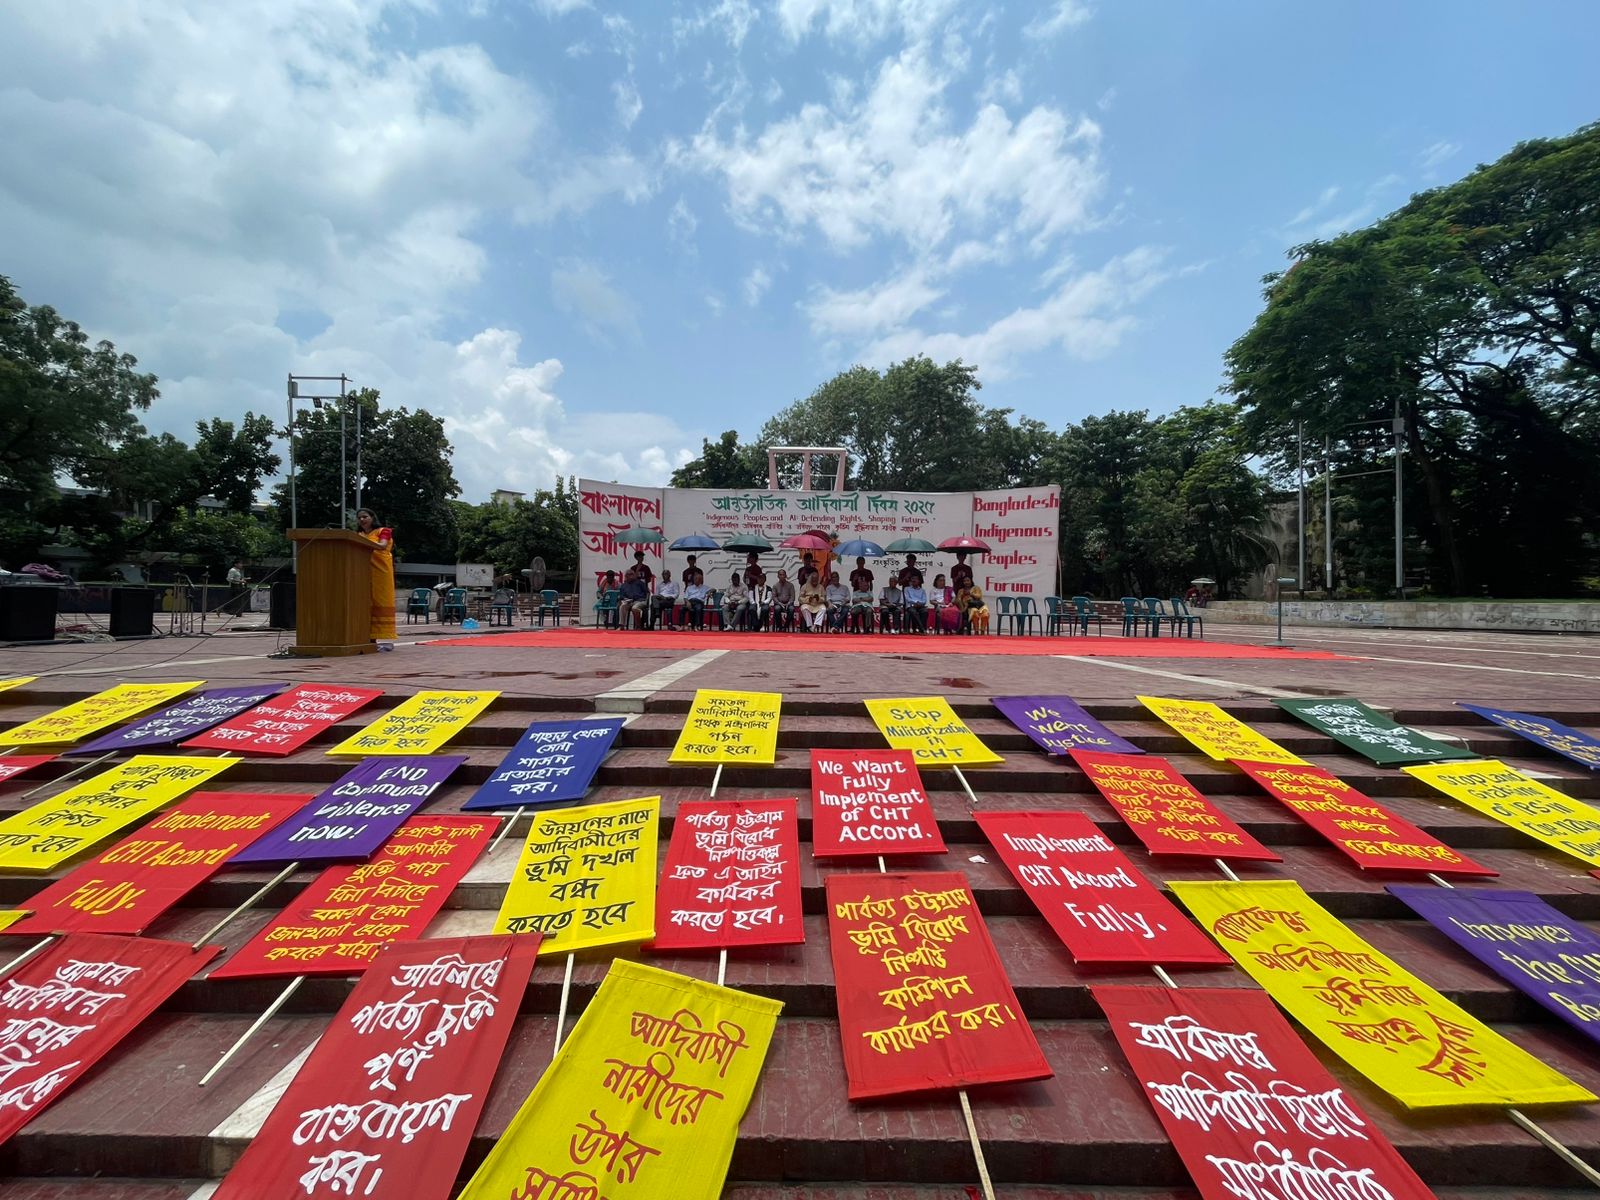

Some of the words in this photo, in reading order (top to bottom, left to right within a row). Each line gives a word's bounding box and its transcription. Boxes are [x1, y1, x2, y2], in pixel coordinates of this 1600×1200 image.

[580, 490, 661, 522] বাংলাদেশ
[795, 492, 859, 514] আদিবাসী
[867, 494, 898, 514] দিবস
[973, 492, 1059, 517] Bangladesh
[975, 523, 1053, 543] Indigenous
[981, 549, 1037, 570] Peoples
[985, 576, 1033, 593] Forum
[890, 709, 941, 721] Stop
[530, 731, 571, 743] পাহাড়
[573, 728, 611, 739] থেকে
[537, 742, 574, 753] সেনা
[916, 748, 962, 758] CHT
[377, 766, 428, 780] END
[518, 755, 573, 768] শাসন
[818, 761, 843, 774] We
[852, 760, 905, 773] Want
[492, 766, 575, 782] প্রত্যাহার
[843, 774, 890, 791] Fully
[820, 789, 923, 810] Implement
[151, 811, 270, 832] Implement
[619, 810, 651, 825] নামে
[685, 811, 731, 830] পার্বত্য
[736, 810, 784, 827] চট্টগ্রাম
[841, 806, 863, 822] of
[870, 806, 911, 820] CHT
[289, 825, 367, 841] now!
[530, 827, 643, 854] আদিবাসীদের
[696, 830, 729, 849] ভূমি
[730, 826, 779, 846] বিরোধ
[100, 841, 168, 863] CHT
[143, 842, 237, 866] Accord
[1003, 834, 1113, 859] Implement
[346, 860, 396, 883] মুক্তি
[392, 862, 449, 878] পায়
[526, 855, 572, 881] ভূমি
[583, 847, 639, 871] দখল
[714, 866, 730, 879] এ
[1019, 865, 1060, 886] CHT
[1060, 867, 1137, 888] Accord
[54, 880, 145, 914] Fully.
[326, 885, 376, 902] বিনা
[372, 877, 438, 901] বিচারে
[550, 878, 604, 901] বন্ধ
[697, 881, 781, 903] কার্যকর
[370, 905, 420, 920] কেন
[582, 901, 635, 929] হবে
[836, 895, 896, 920] পার্বত্য
[900, 889, 970, 916] চট্টগ্রাম
[353, 923, 409, 937] থেকে
[671, 910, 727, 931] করতে
[1064, 903, 1166, 938] Fully.
[848, 922, 900, 954] ভূমি
[900, 913, 968, 943] বিরোধ
[265, 945, 334, 960] কবরে
[1248, 942, 1391, 976] আদিবাসীদের
[50, 960, 141, 986] আমার
[392, 954, 503, 989] অবিলম্বে
[1498, 950, 1584, 984] the
[879, 976, 973, 1010] কমিশন
[1303, 977, 1378, 1016] ভূমি
[351, 991, 439, 1039] পার্বত্য
[420, 990, 498, 1048] চুক্তি
[629, 1009, 749, 1078] আদিবাসী
[863, 1011, 950, 1054] কার্যকর
[1129, 1016, 1276, 1071] অবিলম্বে
[364, 1045, 433, 1090] পূর্ণ
[604, 1054, 725, 1125] নারীদের
[1147, 1071, 1287, 1134] আদিবাসী
[293, 1094, 472, 1145] বাস্তবায়ন
[569, 1110, 662, 1184] উপর
